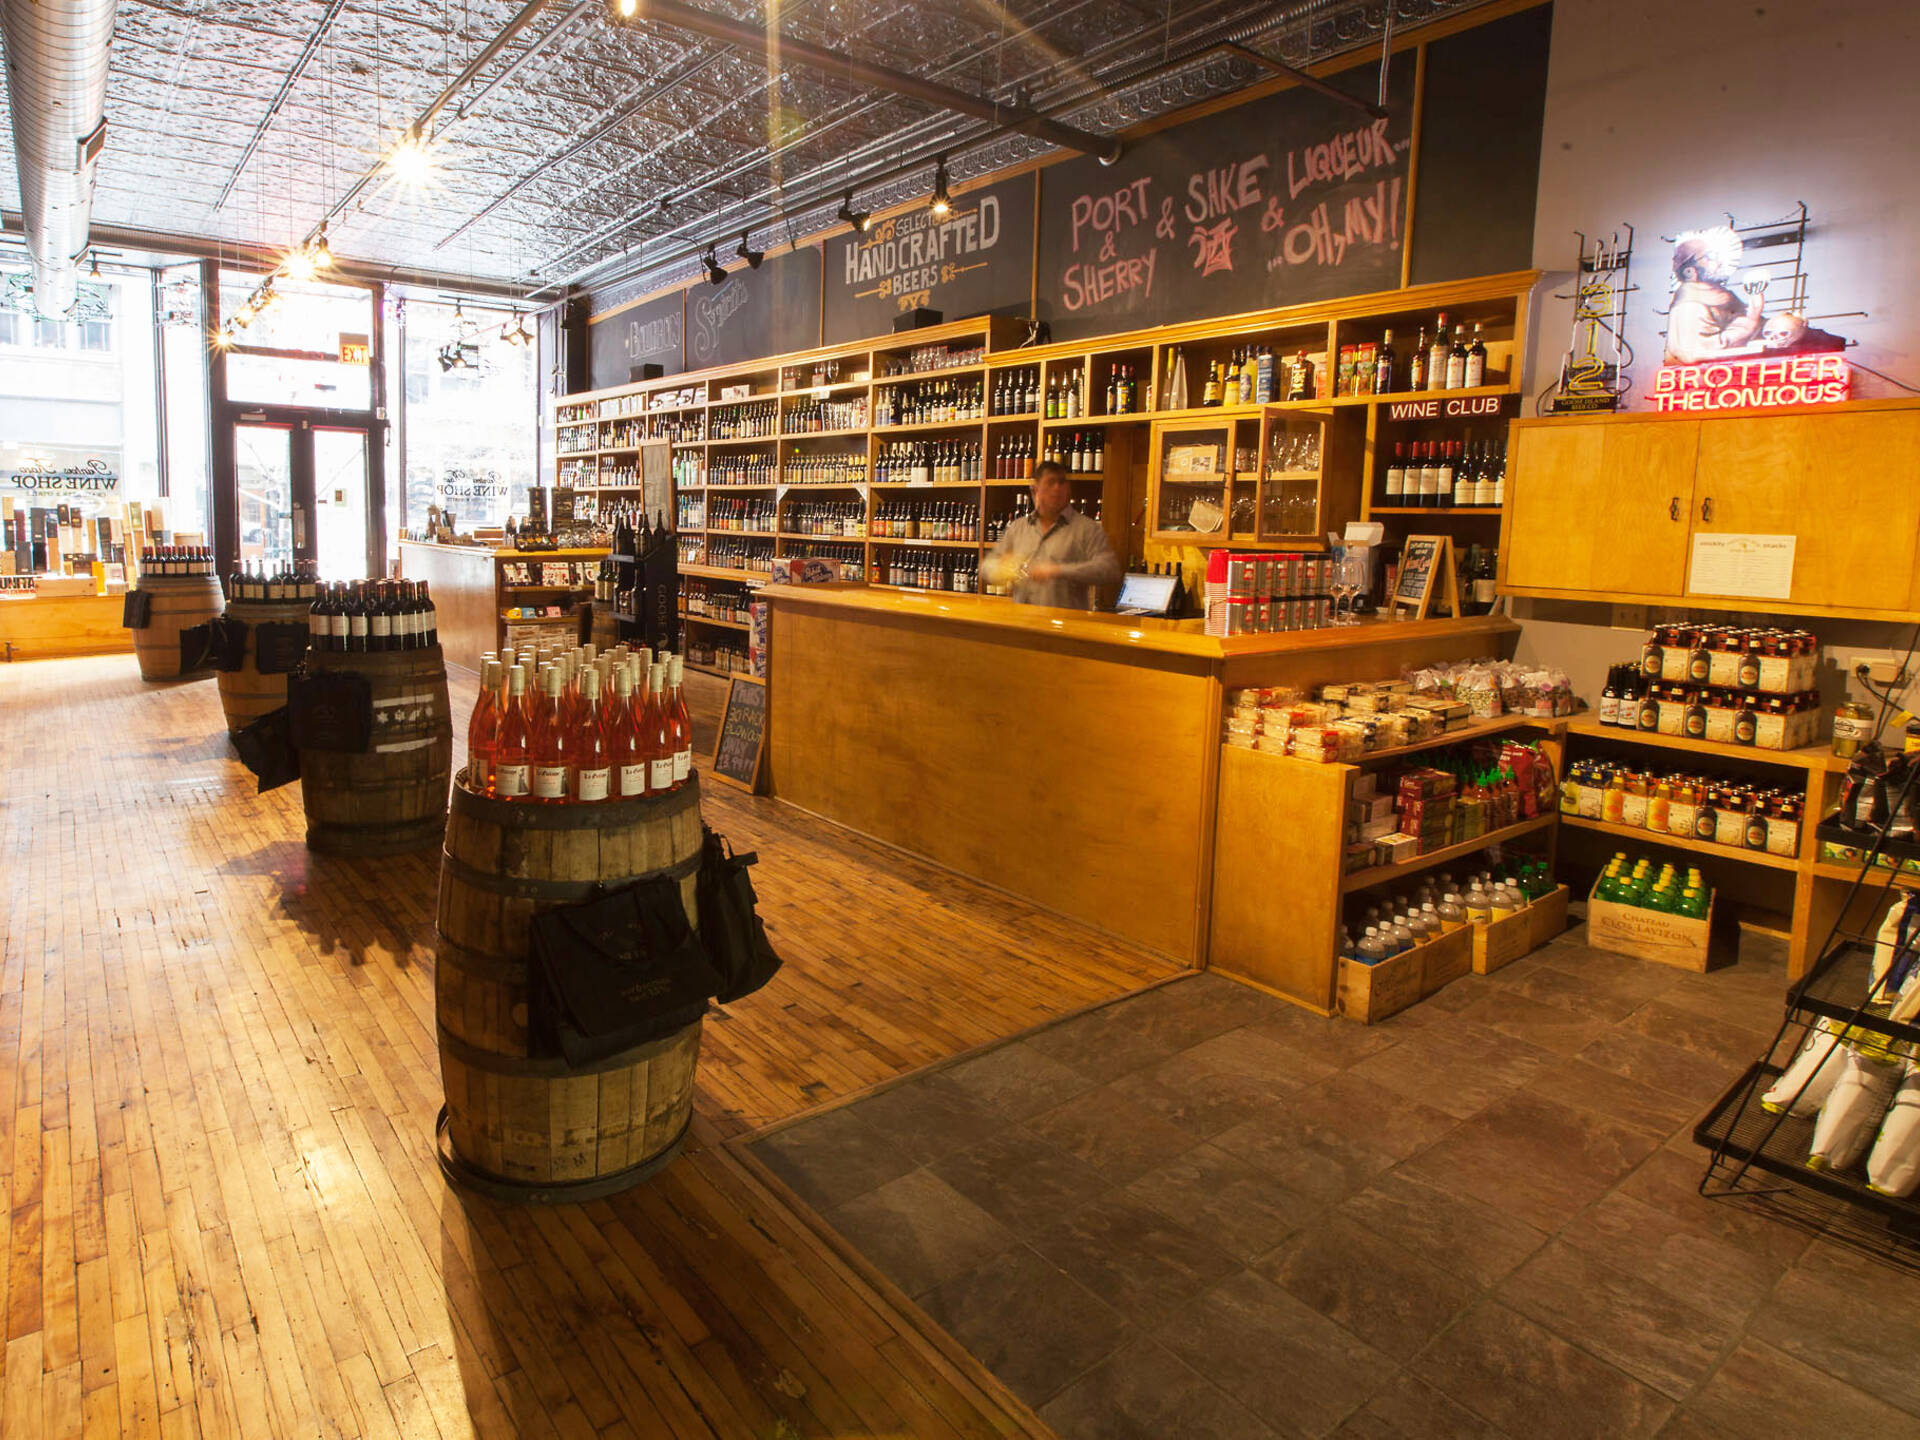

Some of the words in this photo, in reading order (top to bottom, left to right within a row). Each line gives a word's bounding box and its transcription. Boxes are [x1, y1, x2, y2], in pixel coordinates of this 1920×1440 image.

[1071, 177, 1152, 252] PORT
[1155, 197, 1176, 240] &
[1184, 153, 1269, 223] SAKE
[1260, 196, 1285, 232] &
[845, 194, 1000, 285] HANDCRAFTED
[1099, 231, 1118, 262] &
[892, 264, 938, 296] BEERS
[1063, 248, 1158, 311] SHERRY
[342, 346, 366, 363] EXIT
[1655, 355, 1844, 393] BROTHER
[1391, 401, 1439, 419] WINE
[1446, 397, 1499, 415] CLUB
[1653, 382, 1843, 412] THELONIOUS
